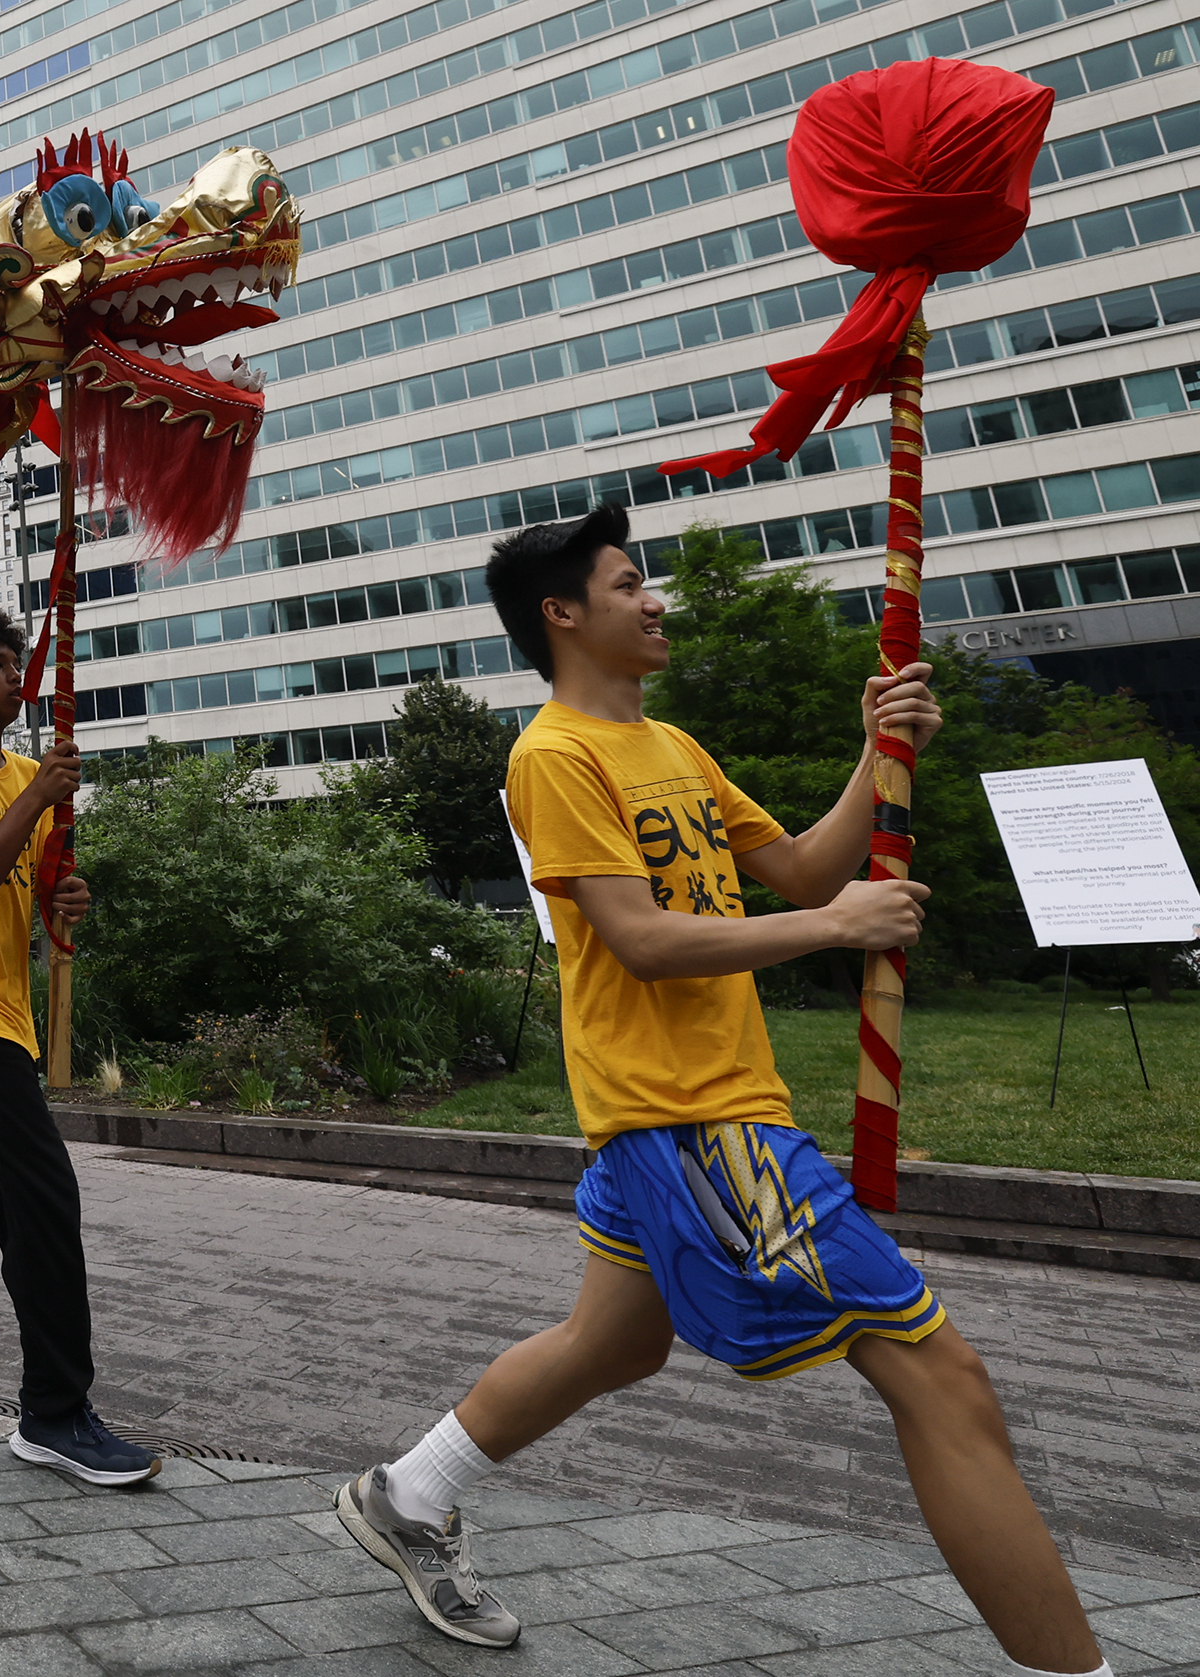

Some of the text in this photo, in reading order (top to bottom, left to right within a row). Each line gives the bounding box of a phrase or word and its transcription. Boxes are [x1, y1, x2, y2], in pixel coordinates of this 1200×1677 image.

[961, 623, 1077, 650] CENTER
[1040, 769, 1077, 777] Nicaragua
[1056, 803, 1086, 811] specific
[1034, 812, 1066, 820] strength
[1054, 867, 1098, 876] helped/has
[1098, 865, 1126, 873] helped
[407, 1547, 447, 1574] N
